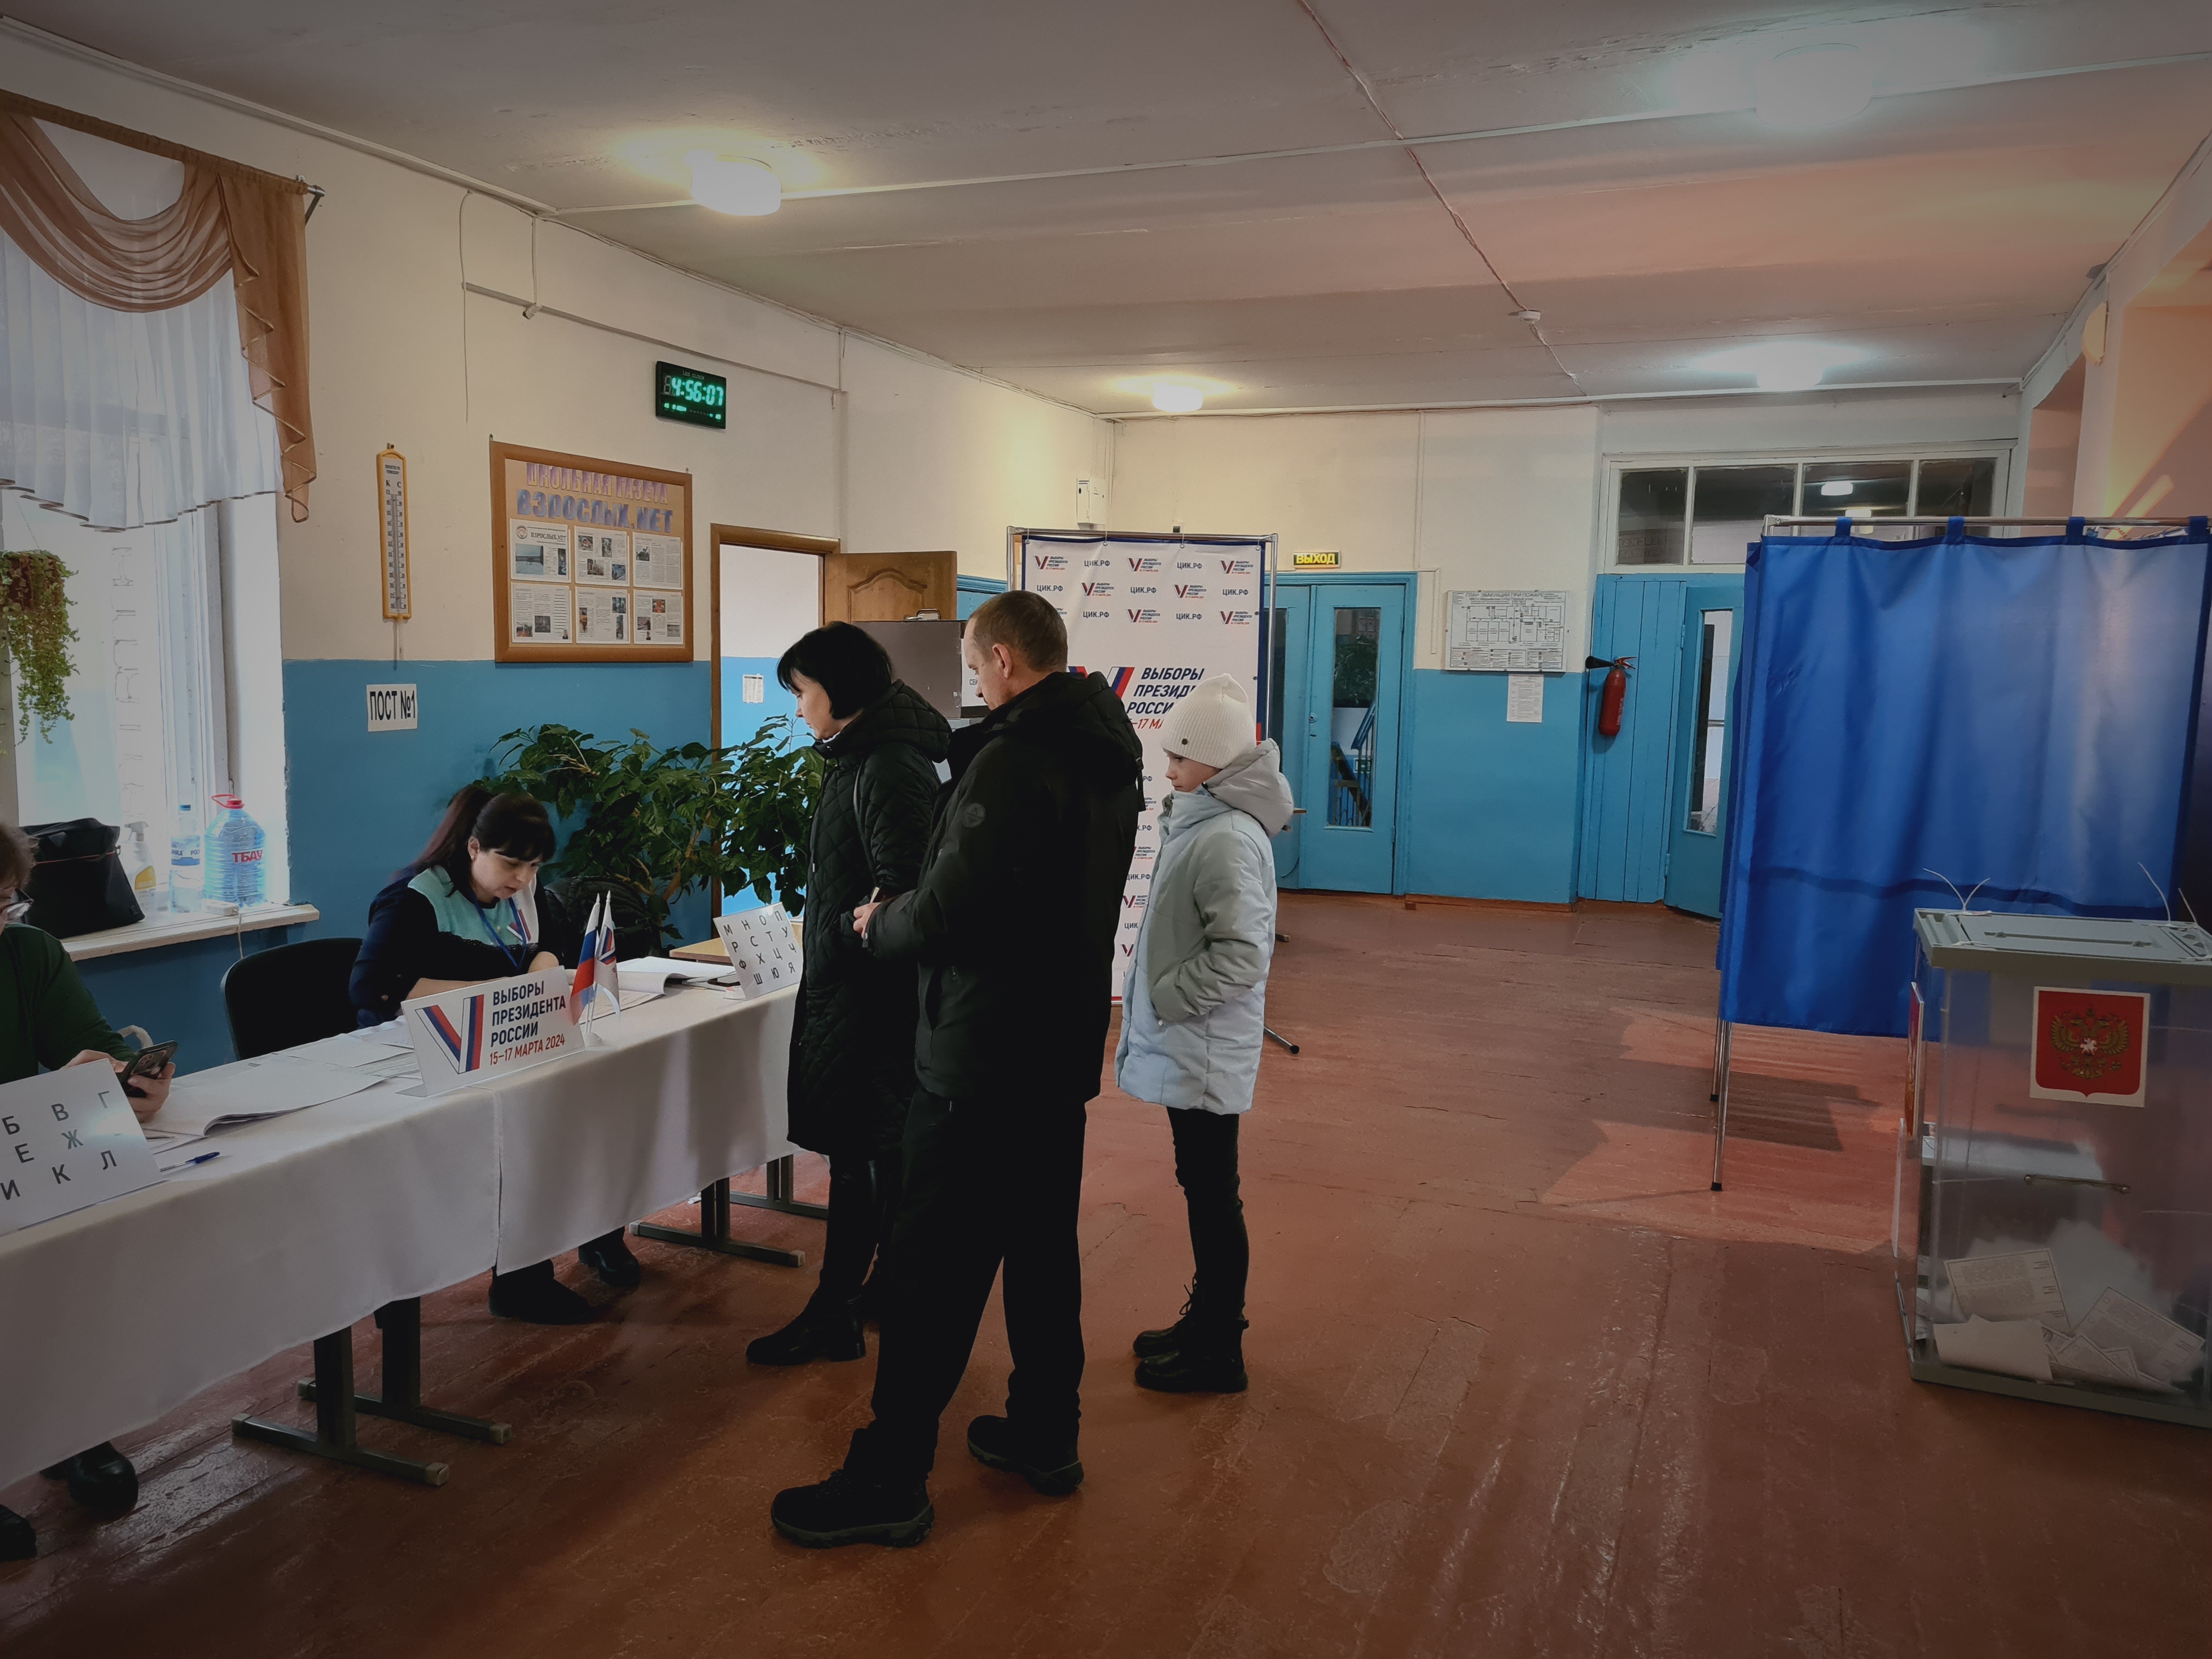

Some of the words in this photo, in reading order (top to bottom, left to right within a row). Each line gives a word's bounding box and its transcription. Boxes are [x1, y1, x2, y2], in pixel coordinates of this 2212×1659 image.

[526, 462, 612, 497] ШКОЛЬНАЯ
[616, 475, 668, 505] ГАЗЕТА
[1296, 553, 1335, 564] ВЫХОД
[1141, 668, 1205, 680] ВЫБОРЫ
[1133, 685, 1197, 699] ПРЕЗИД
[370, 691, 397, 721] ПОСТ
[400, 690, 415, 719] №1
[723, 924, 733, 936] М
[741, 919, 751, 930] Н
[759, 915, 766, 926] О
[775, 911, 783, 921] П
[731, 941, 738, 953] Р
[750, 936, 758, 947] С
[765, 931, 773, 941] Т
[781, 926, 788, 938] У
[739, 959, 747, 969] Ф
[756, 952, 765, 964] Х
[773, 947, 783, 960] Ц
[788, 943, 797, 953] Ч
[753, 973, 763, 985] Ш
[771, 967, 780, 979] Ю
[788, 962, 795, 973] Я
[493, 980, 544, 1006] ВЫБОРЫ
[492, 995, 566, 1026] ПРЕЗИДЕНТА
[490, 1021, 538, 1047] РОССИИ
[514, 1039, 543, 1059] МАРТА
[545, 1034, 565, 1049] 2024
[2, 1116, 20, 1135] Б
[51, 1103, 69, 1121] В
[98, 1091, 110, 1108] Г
[15, 1143, 35, 1164] Е
[61, 1129, 83, 1149] Ж
[1, 1180, 21, 1200] И
[52, 1164, 71, 1184] К
[100, 1150, 117, 1170] Л
